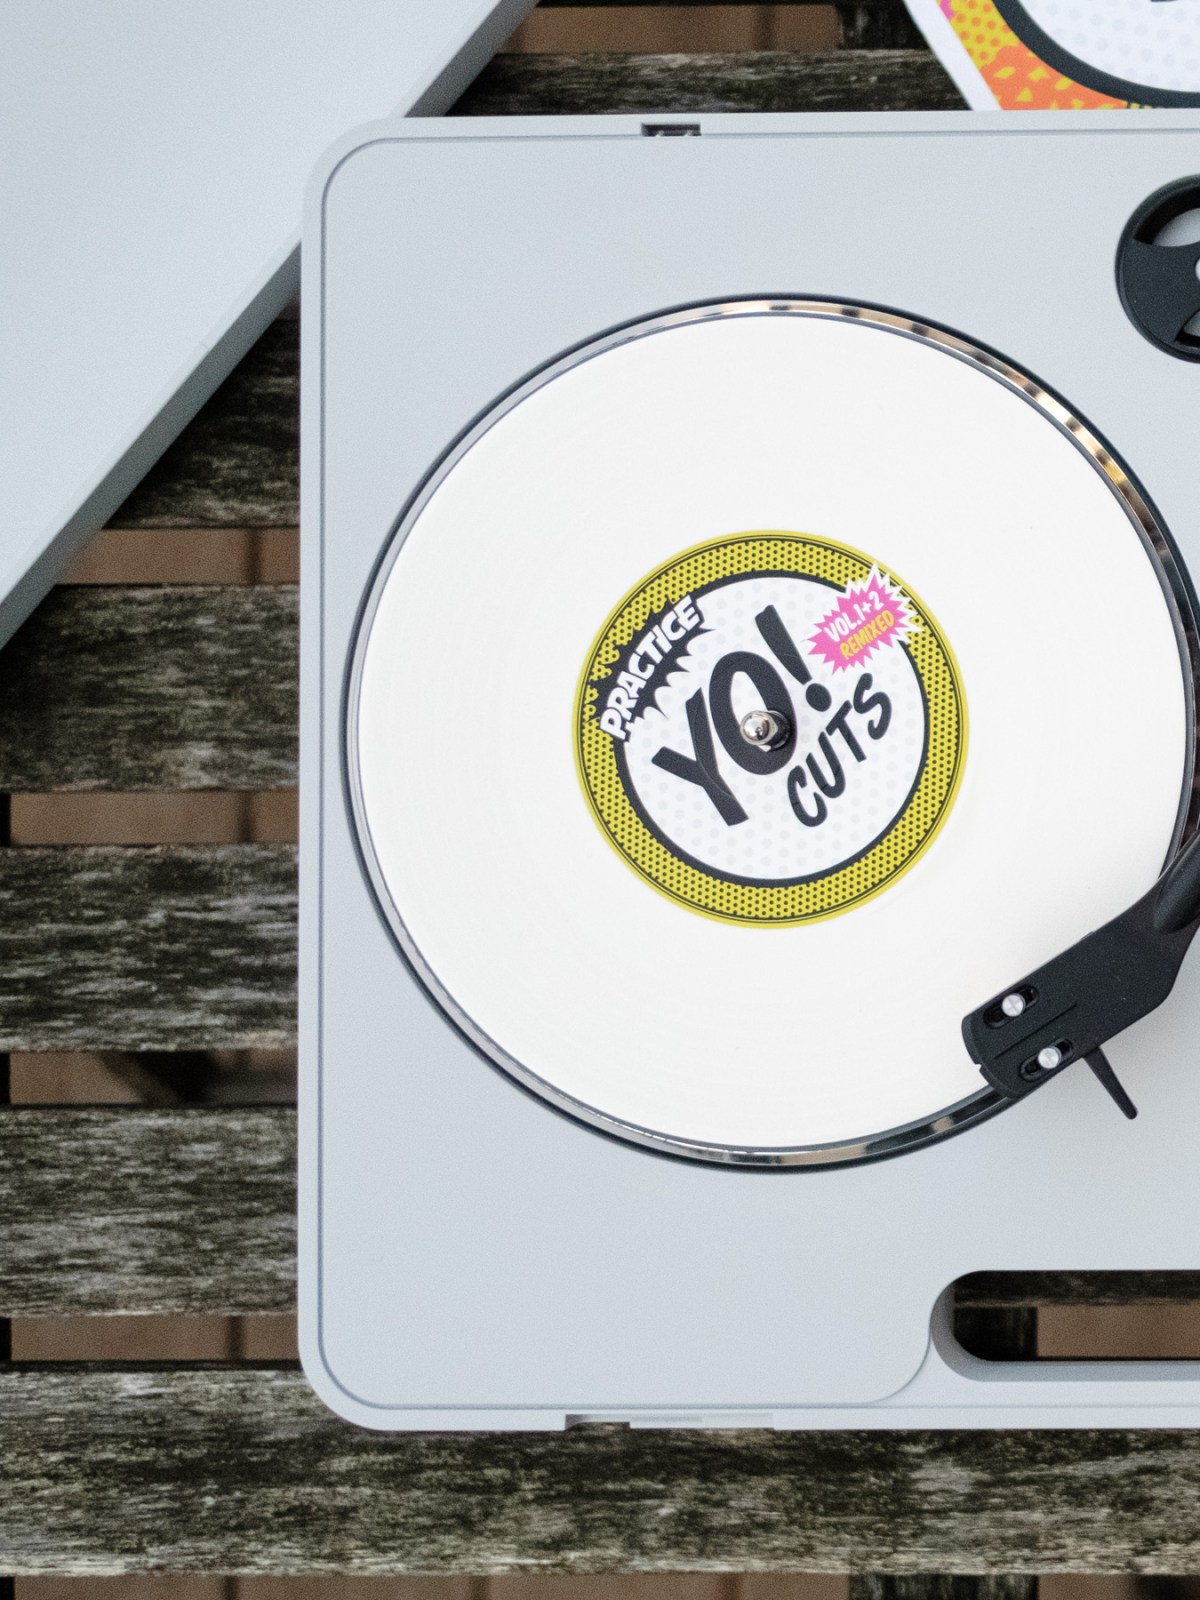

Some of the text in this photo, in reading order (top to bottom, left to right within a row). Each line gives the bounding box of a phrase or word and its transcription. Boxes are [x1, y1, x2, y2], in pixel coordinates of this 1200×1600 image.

[599, 595, 703, 742] PRACTICE
[839, 610, 894, 660] REMIXED
[650, 604, 832, 827] YO!
[787, 672, 892, 828] CUTS
